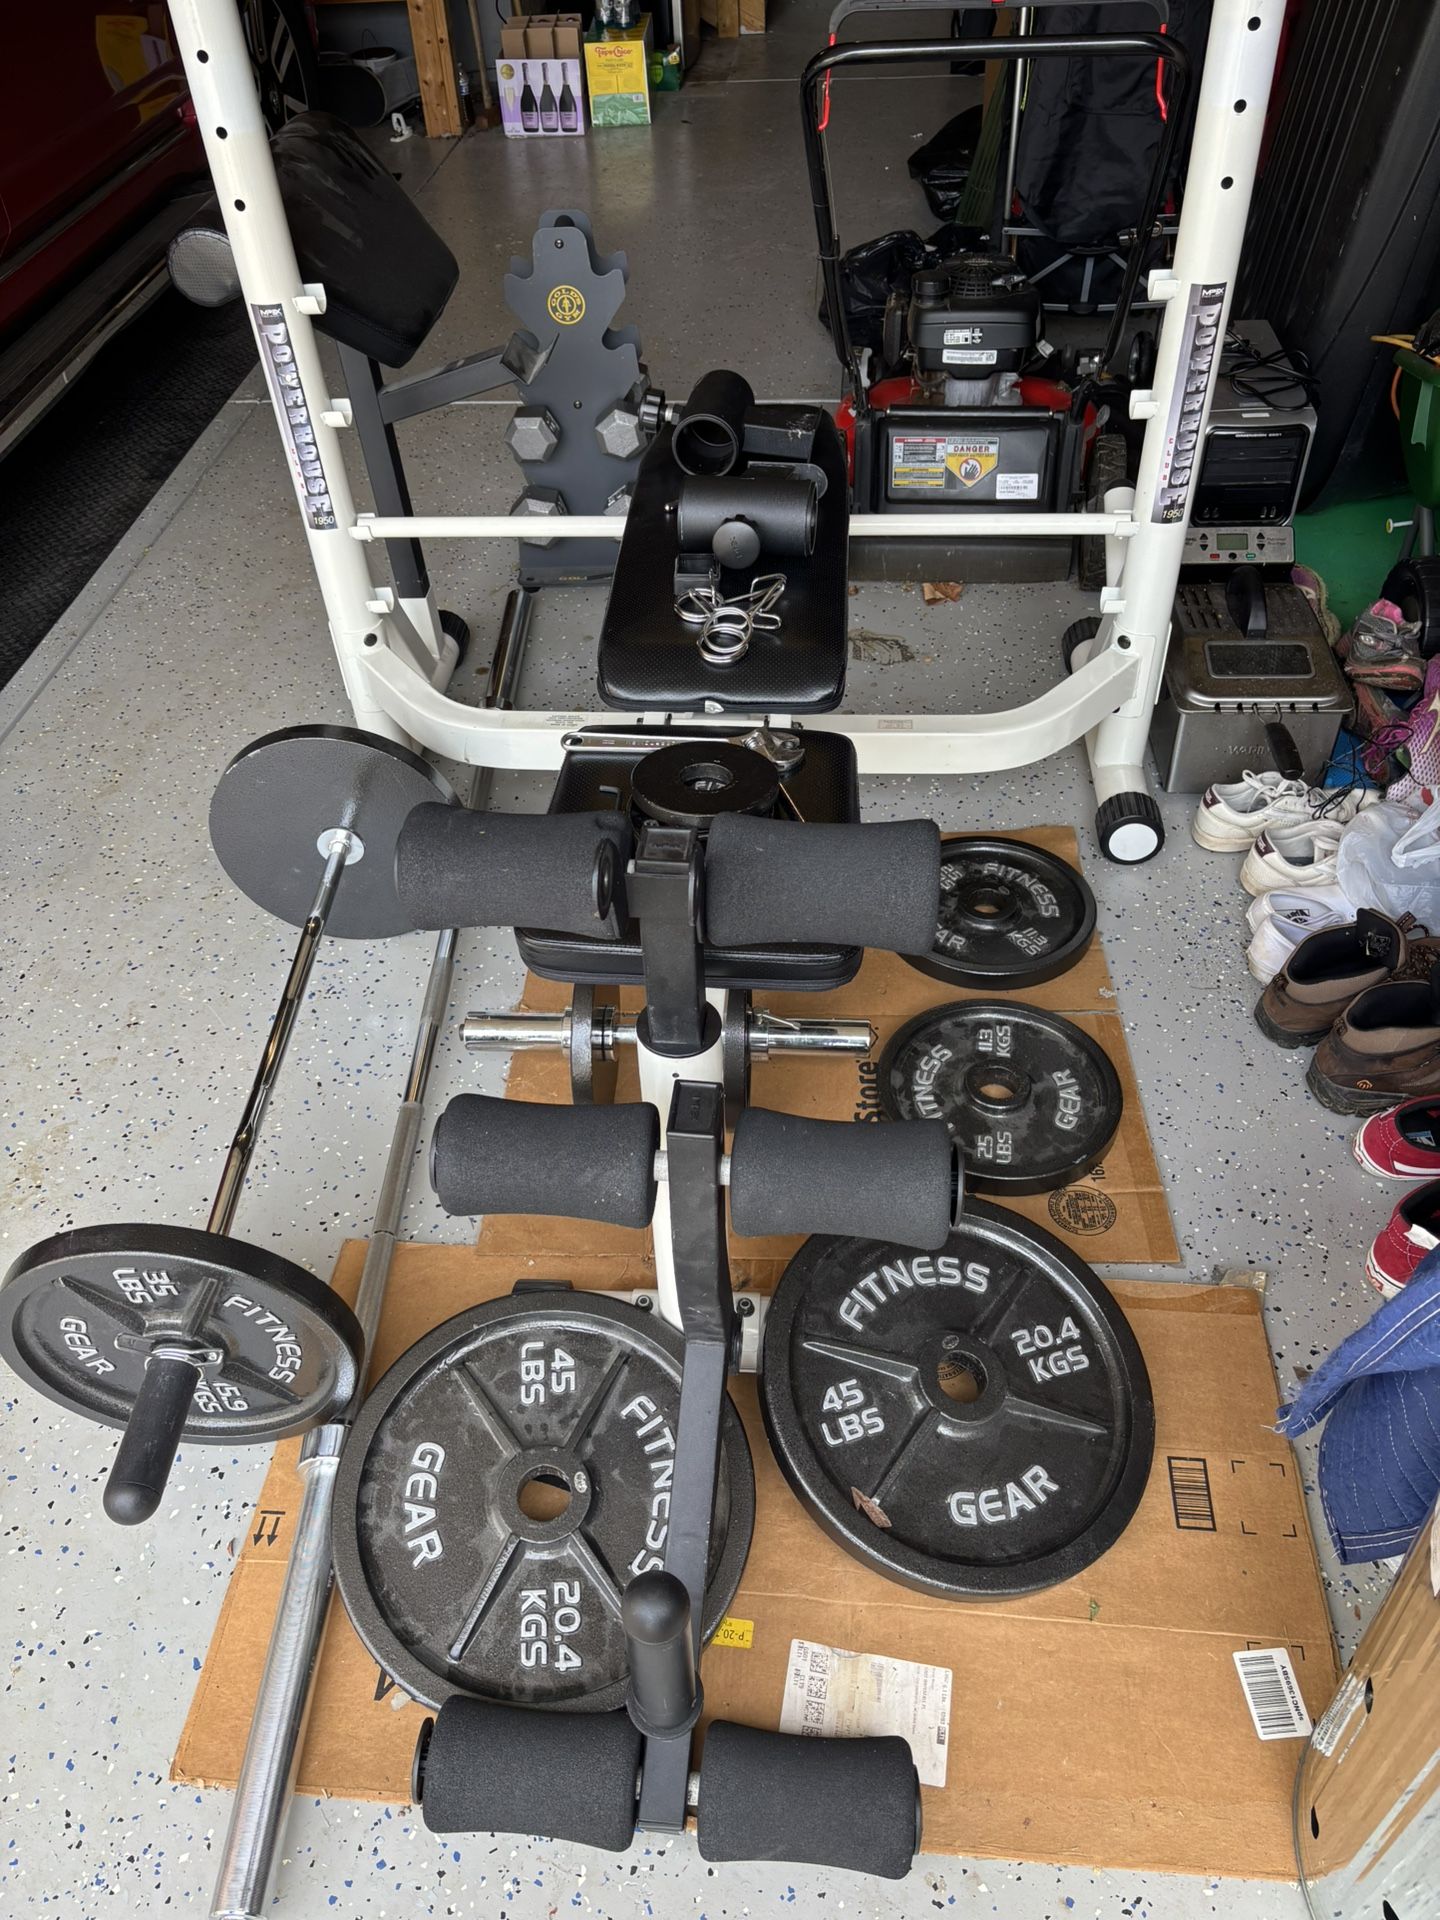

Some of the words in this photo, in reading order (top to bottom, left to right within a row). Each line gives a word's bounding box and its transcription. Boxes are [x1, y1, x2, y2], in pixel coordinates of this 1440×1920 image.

[262, 322, 334, 514] POWERHOUSE
[1160, 303, 1222, 507] POWERHOUSE
[953, 445, 990, 453] DANGER
[313, 515, 335, 525] 1950
[1161, 508, 1184, 519] 1950
[983, 862, 1060, 918] FITNESS
[935, 923, 967, 950] AR
[1006, 930, 1042, 956] KGS
[978, 1028, 993, 1052] 11.3
[996, 1025, 1011, 1058] KGS
[912, 1043, 953, 1120] ITNESS
[1051, 1068, 1081, 1131] GEAR
[977, 1135, 993, 1158] 25
[996, 1131, 1012, 1164] LBS
[113, 1268, 153, 1304] LBS
[142, 1270, 178, 1297] 35
[838, 1256, 990, 1333] FITNESS
[60, 1317, 115, 1375] GEAR
[223, 1295, 302, 1384] FITNESS
[1011, 1316, 1081, 1357] 20.4
[521, 1341, 546, 1406] LBS
[551, 1347, 577, 1393] 45
[1027, 1345, 1090, 1383] KGS
[212, 1382, 249, 1411] 15.9
[822, 1378, 865, 1413] 45
[821, 1407, 886, 1447] LBS
[403, 1441, 446, 1569] GEAR
[948, 1465, 1060, 1527] GEAR
[520, 1588, 549, 1669] KGS
[553, 1580, 582, 1672] 20.4
